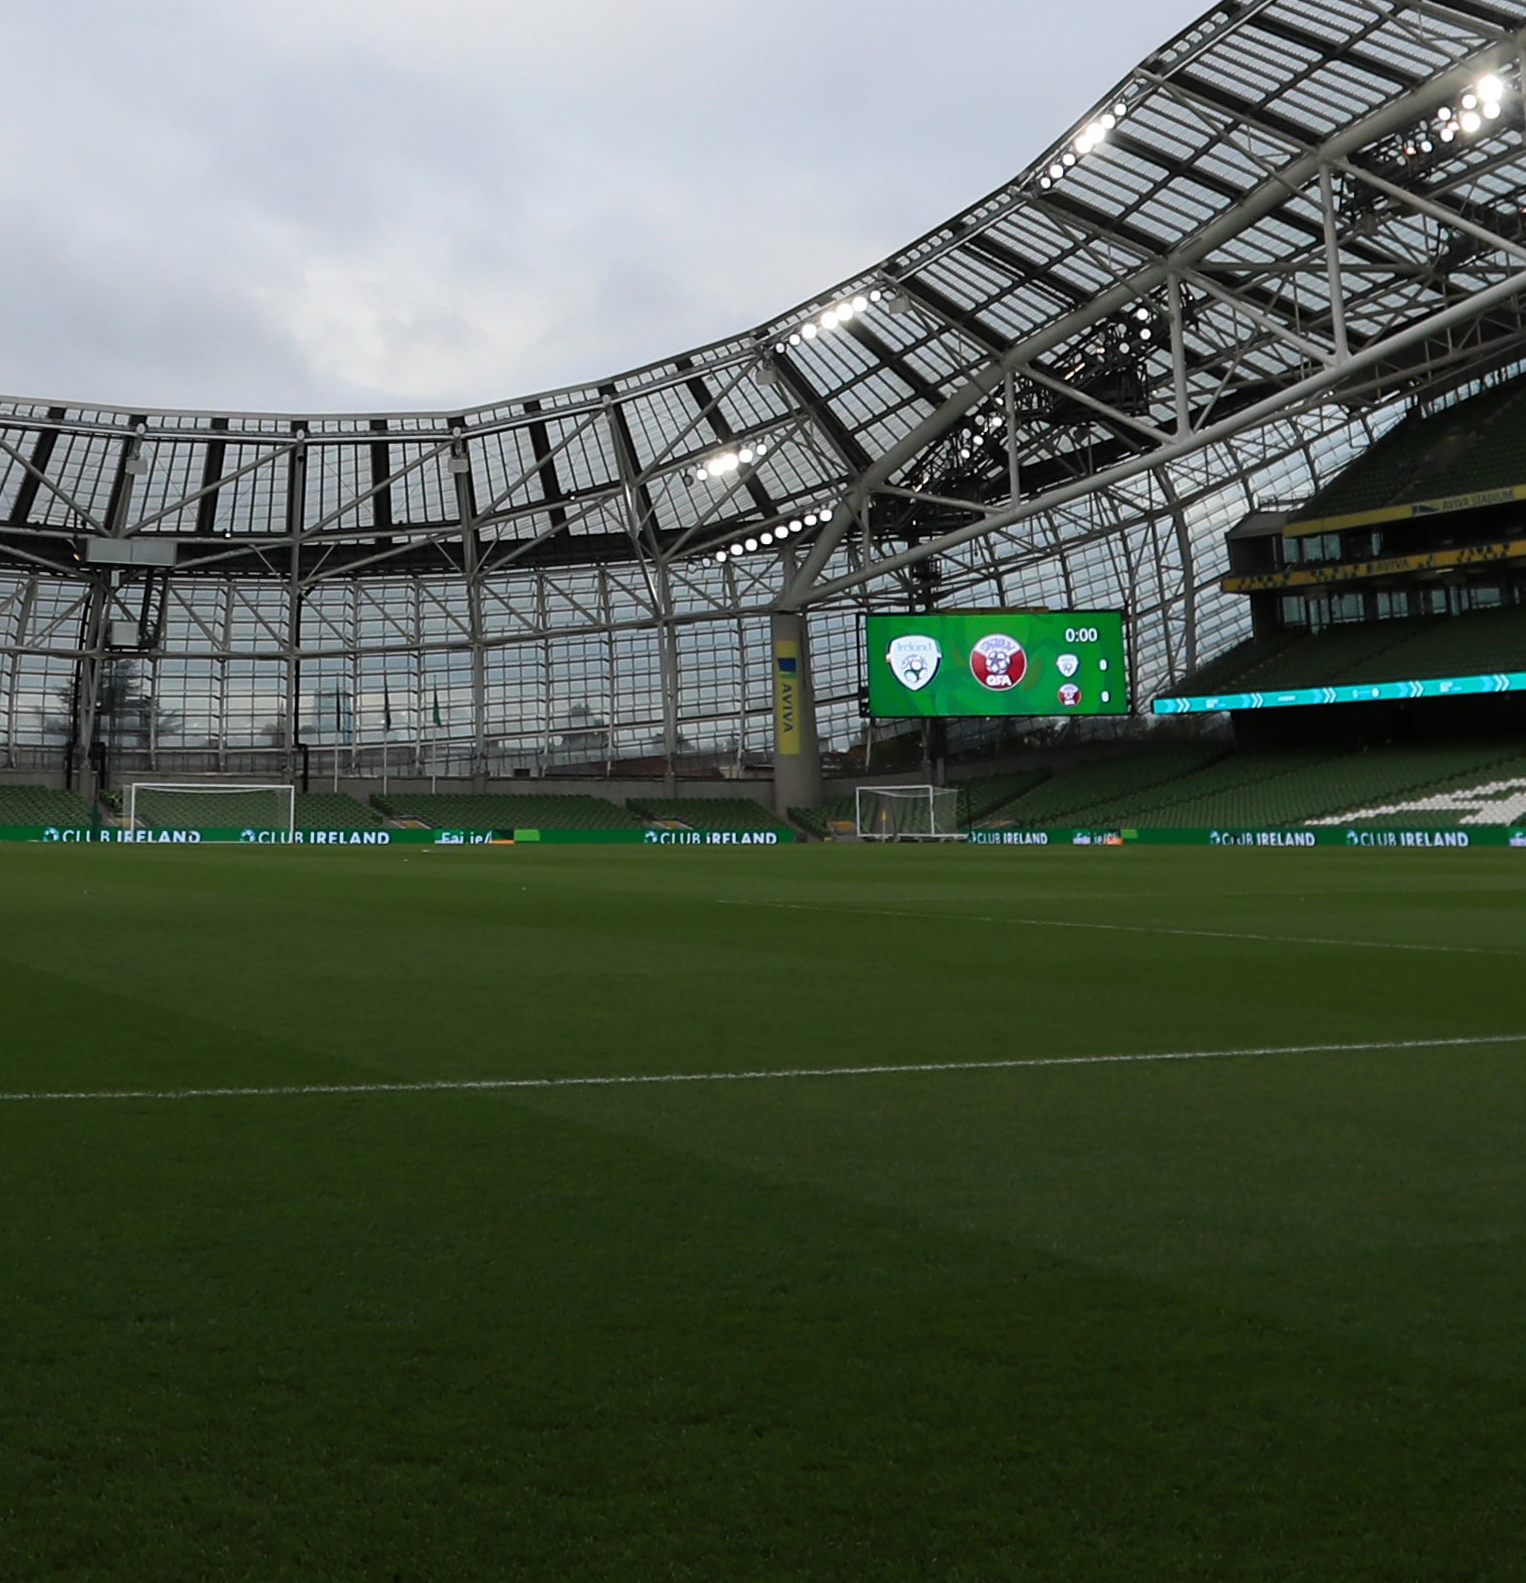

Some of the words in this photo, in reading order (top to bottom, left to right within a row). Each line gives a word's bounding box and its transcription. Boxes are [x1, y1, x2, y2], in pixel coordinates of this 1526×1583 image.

[1065, 628, 1098, 643] 0:00
[985, 674, 1013, 687] QFA
[781, 683, 793, 734] AVIVA
[117, 829, 201, 843] IRELAND
[258, 831, 303, 844] CLUB
[310, 831, 390, 845] IRELAND
[660, 832, 700, 845] CLUB
[706, 832, 777, 846] IRELAND
[977, 832, 1001, 845] CLUB
[1003, 832, 1048, 845] IRELAND
[1256, 832, 1315, 847] IRELAND
[1359, 832, 1397, 846] CLUB
[1401, 832, 1469, 847] IRELAND
